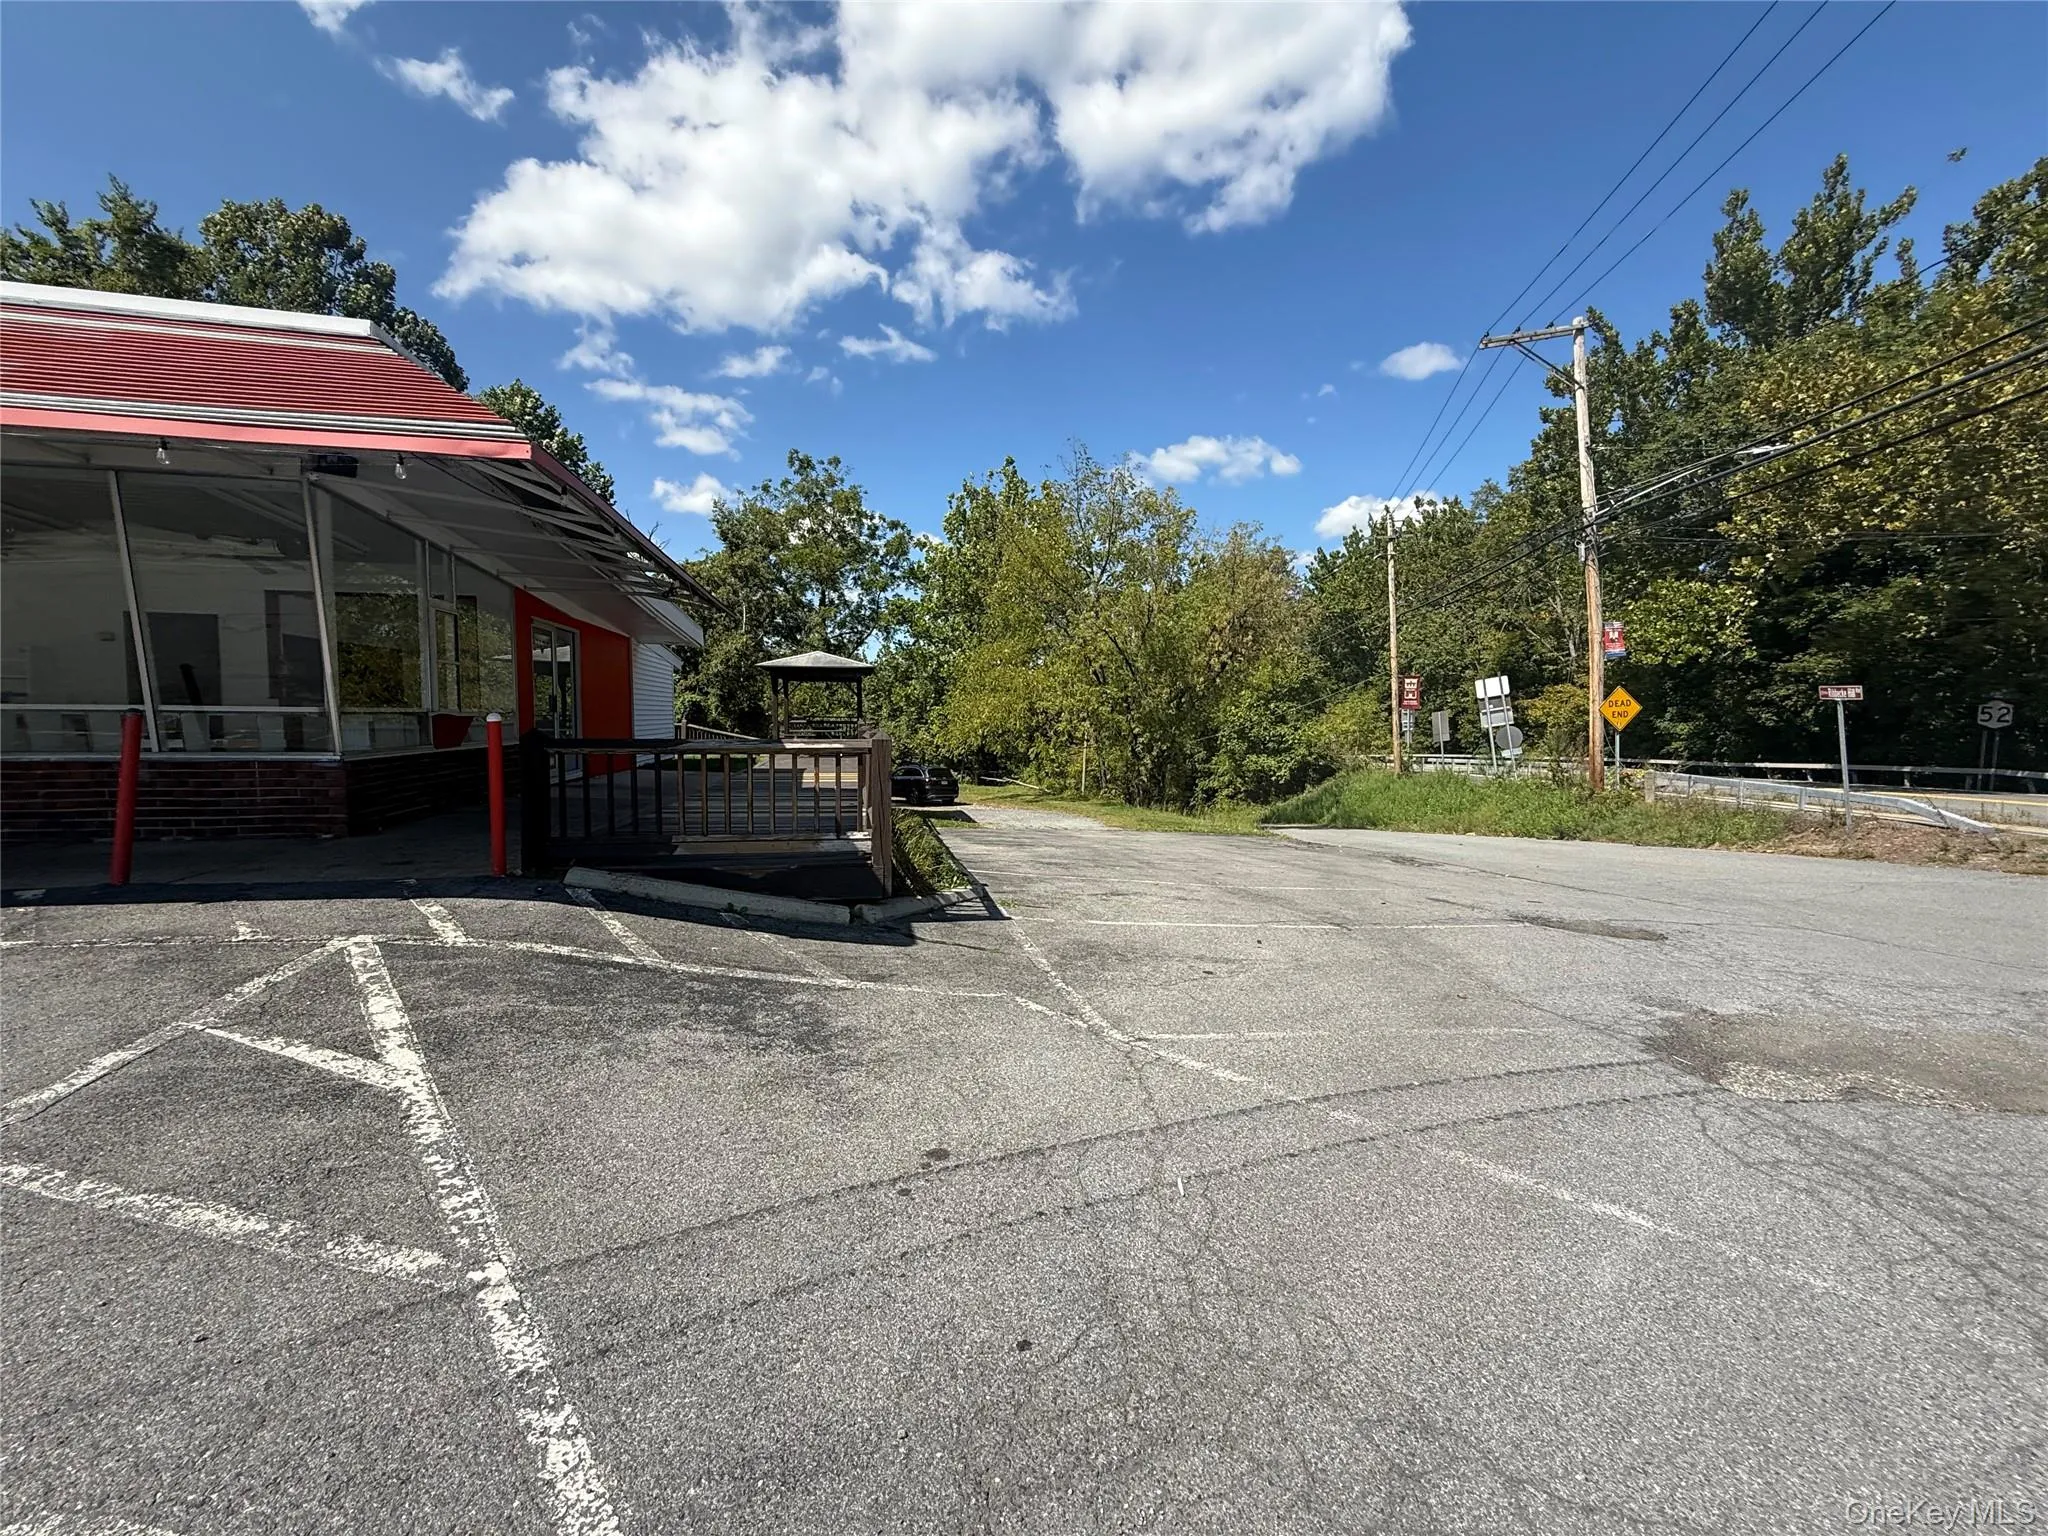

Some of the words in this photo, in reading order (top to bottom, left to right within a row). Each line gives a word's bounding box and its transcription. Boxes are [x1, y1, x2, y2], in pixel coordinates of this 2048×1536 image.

[1609, 699, 1632, 708] DEAD
[1612, 710, 1629, 719] END
[1979, 706, 2010, 723] 52
